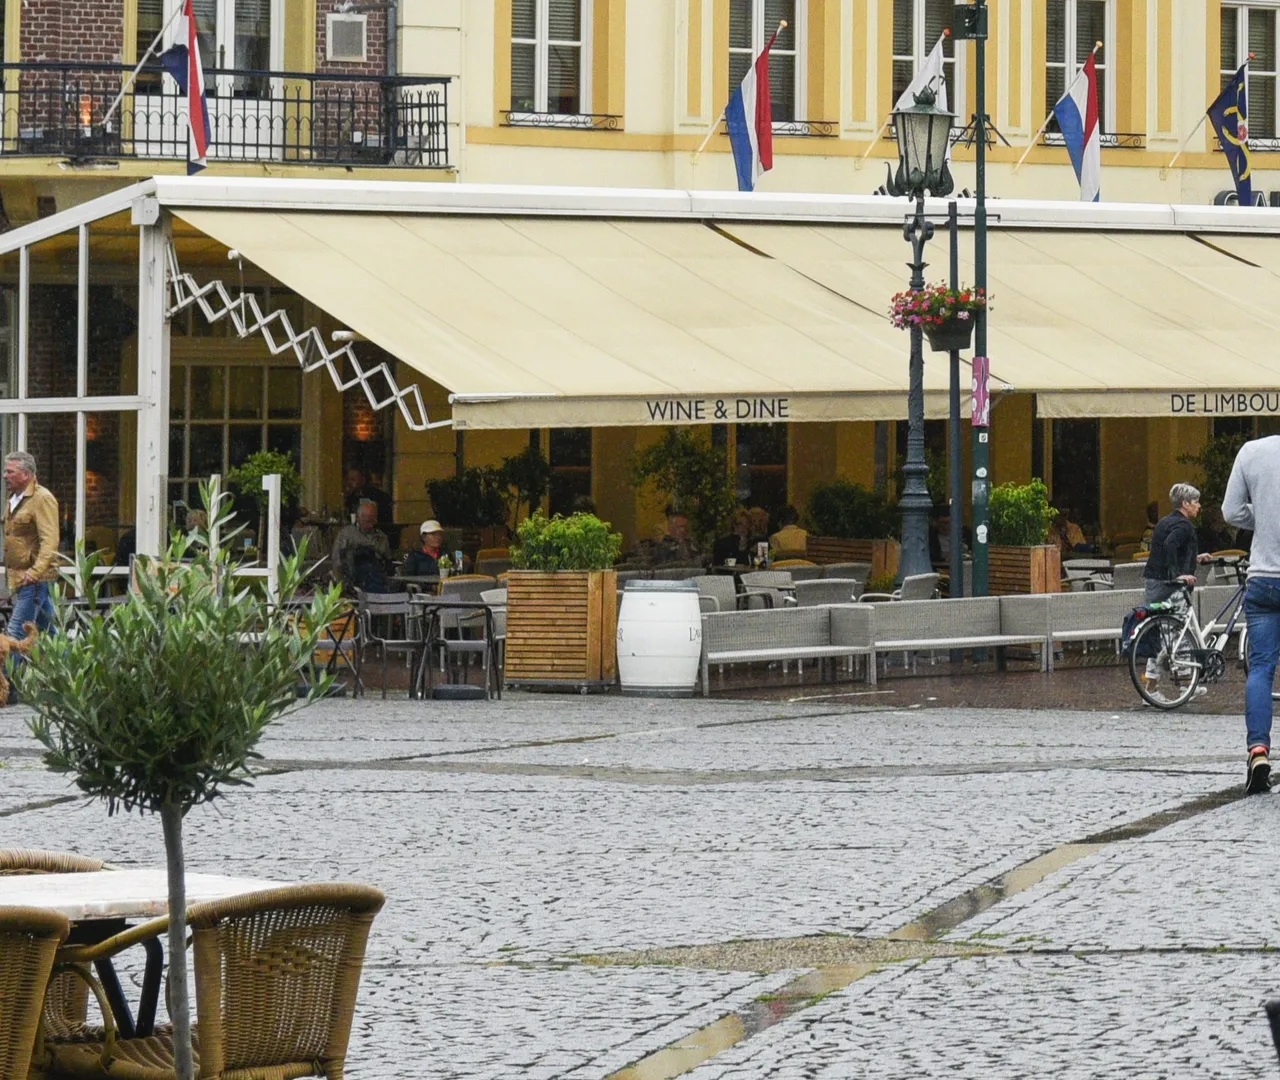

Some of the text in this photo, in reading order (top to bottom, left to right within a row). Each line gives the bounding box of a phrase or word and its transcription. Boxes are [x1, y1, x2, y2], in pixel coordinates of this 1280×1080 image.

[646, 398, 789, 421] WINE & DINE
[1171, 394, 1196, 413] DE
